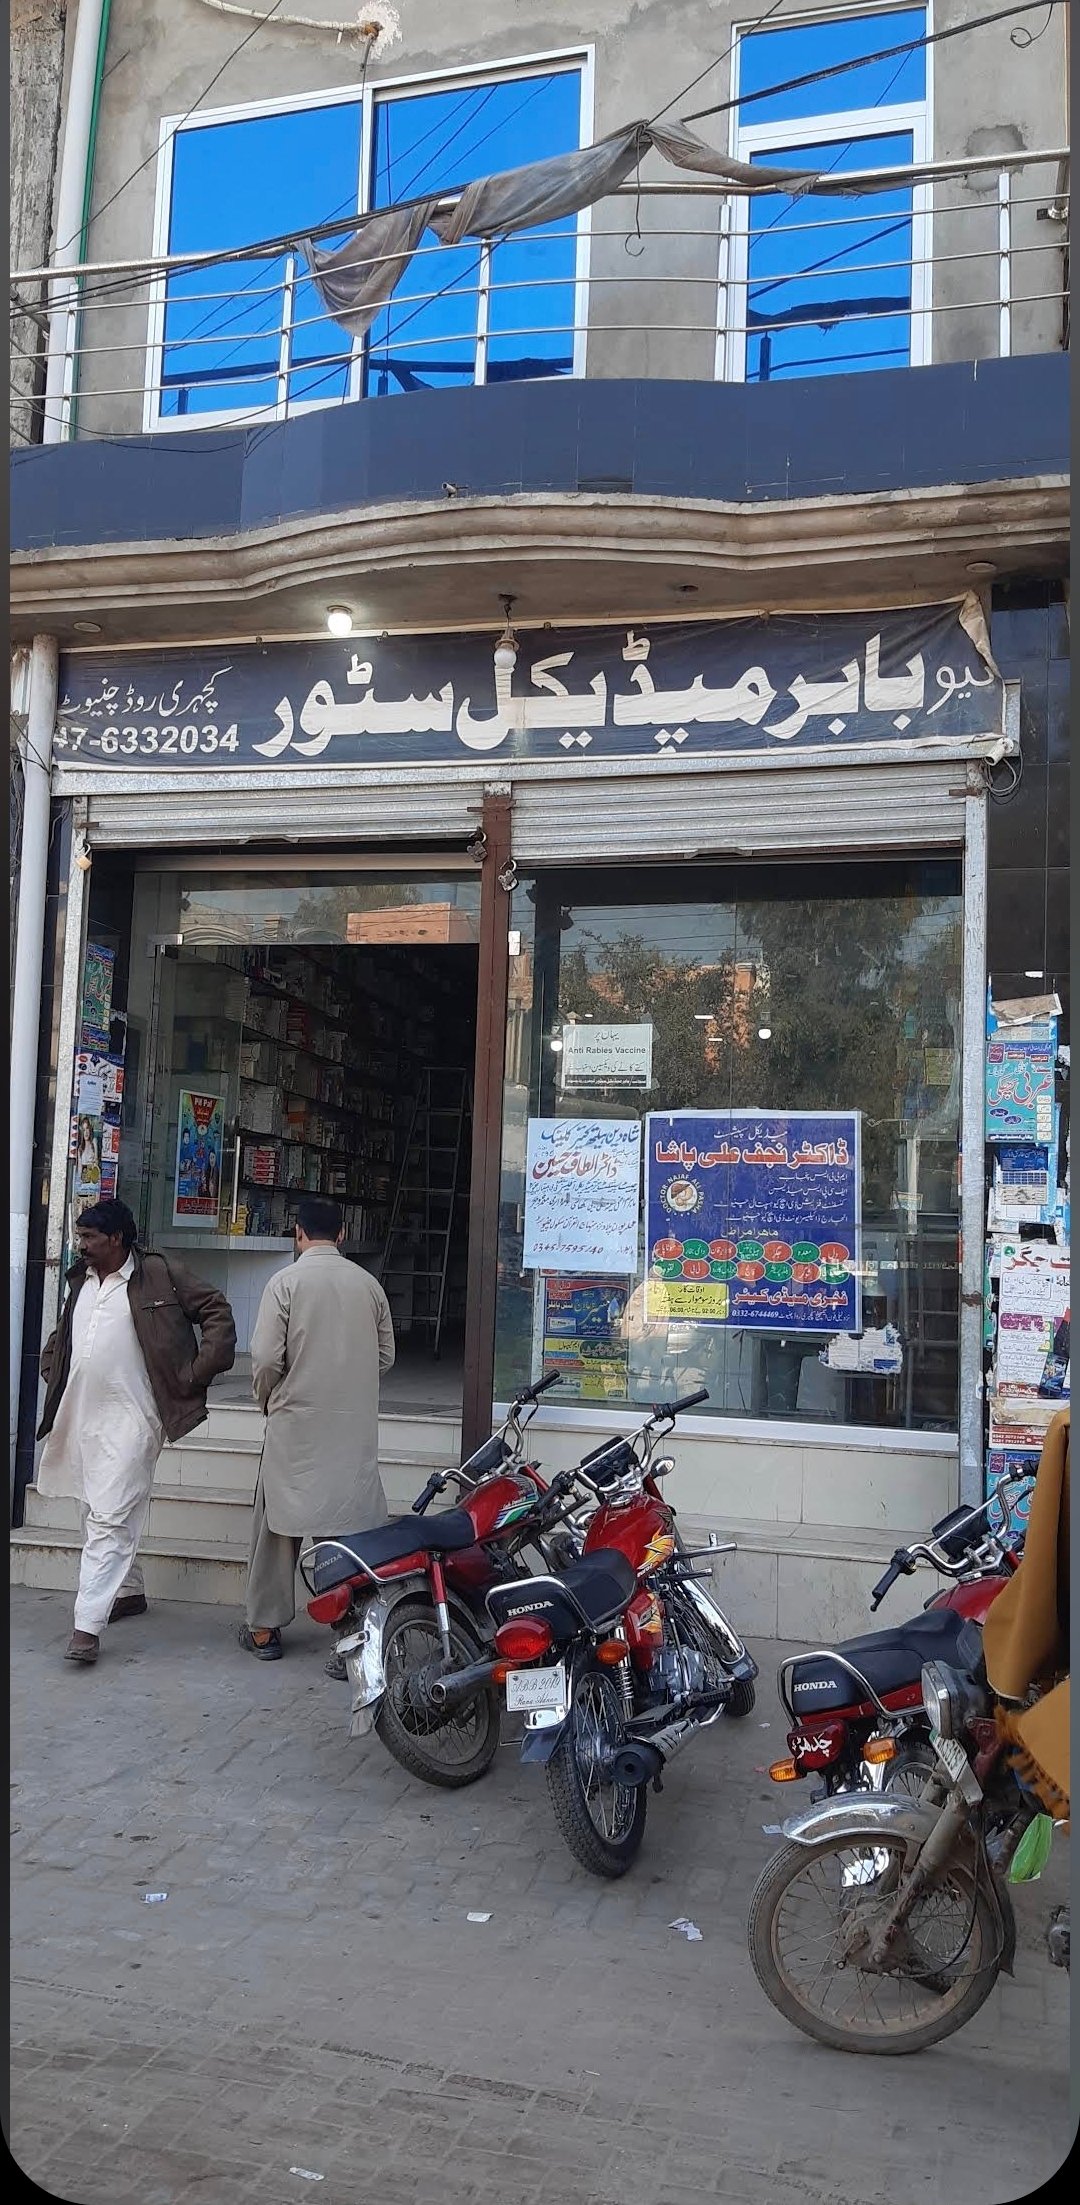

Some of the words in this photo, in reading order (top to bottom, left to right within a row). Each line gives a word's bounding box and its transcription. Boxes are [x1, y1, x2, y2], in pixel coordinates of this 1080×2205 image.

[57, 677, 120, 717] چنیوٹ
[122, 683, 158, 714] روڈ
[159, 666, 233, 718] کچہری
[456, 630, 778, 753] میڈیکل
[762, 633, 925, 740] بابر
[252, 653, 454, 758] سٹور
[568, 1046, 584, 1054] Anti
[586, 1046, 613, 1054] Rabies
[615, 1046, 646, 1054] Vaccine
[748, 1122, 788, 1143] میڈیکل
[655, 1140, 698, 1172] پاشا
[698, 1141, 742, 1169] علی
[742, 1141, 789, 1169] نجف
[787, 1138, 850, 1170] ڈاکٹر
[660, 1184, 672, 1213] DOCTOR
[691, 1178, 702, 1189] ALI
[755, 1227, 779, 1239] ماہر
[809, 1290, 849, 1308] فخری
[314, 1552, 343, 1573] HONDA
[507, 1600, 554, 1616] HONDA
[793, 1680, 838, 1692] HONDA
